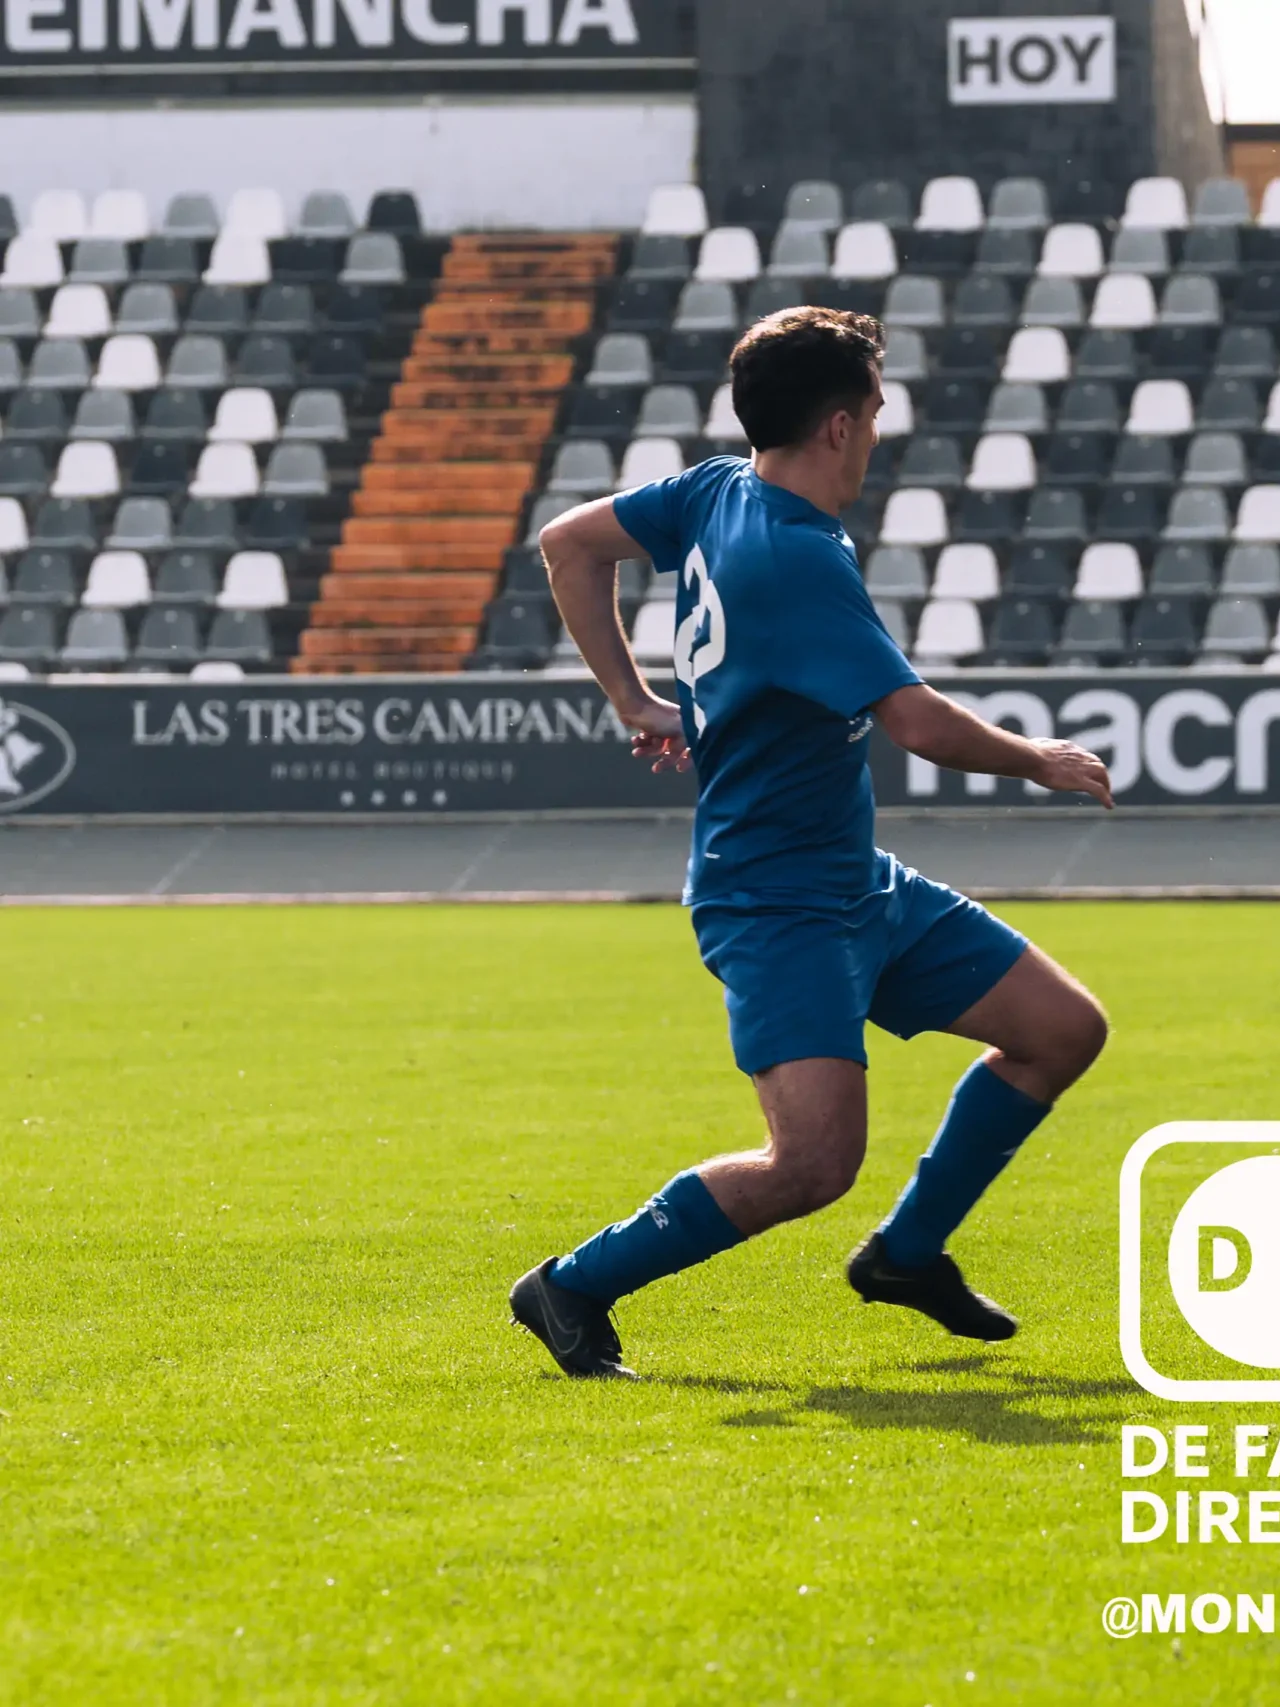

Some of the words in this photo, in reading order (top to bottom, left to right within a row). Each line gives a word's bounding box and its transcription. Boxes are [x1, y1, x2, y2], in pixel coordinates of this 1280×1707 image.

[957, 35, 1103, 85] HOY
[132, 698, 230, 746] LAS
[236, 698, 367, 746] TRES
